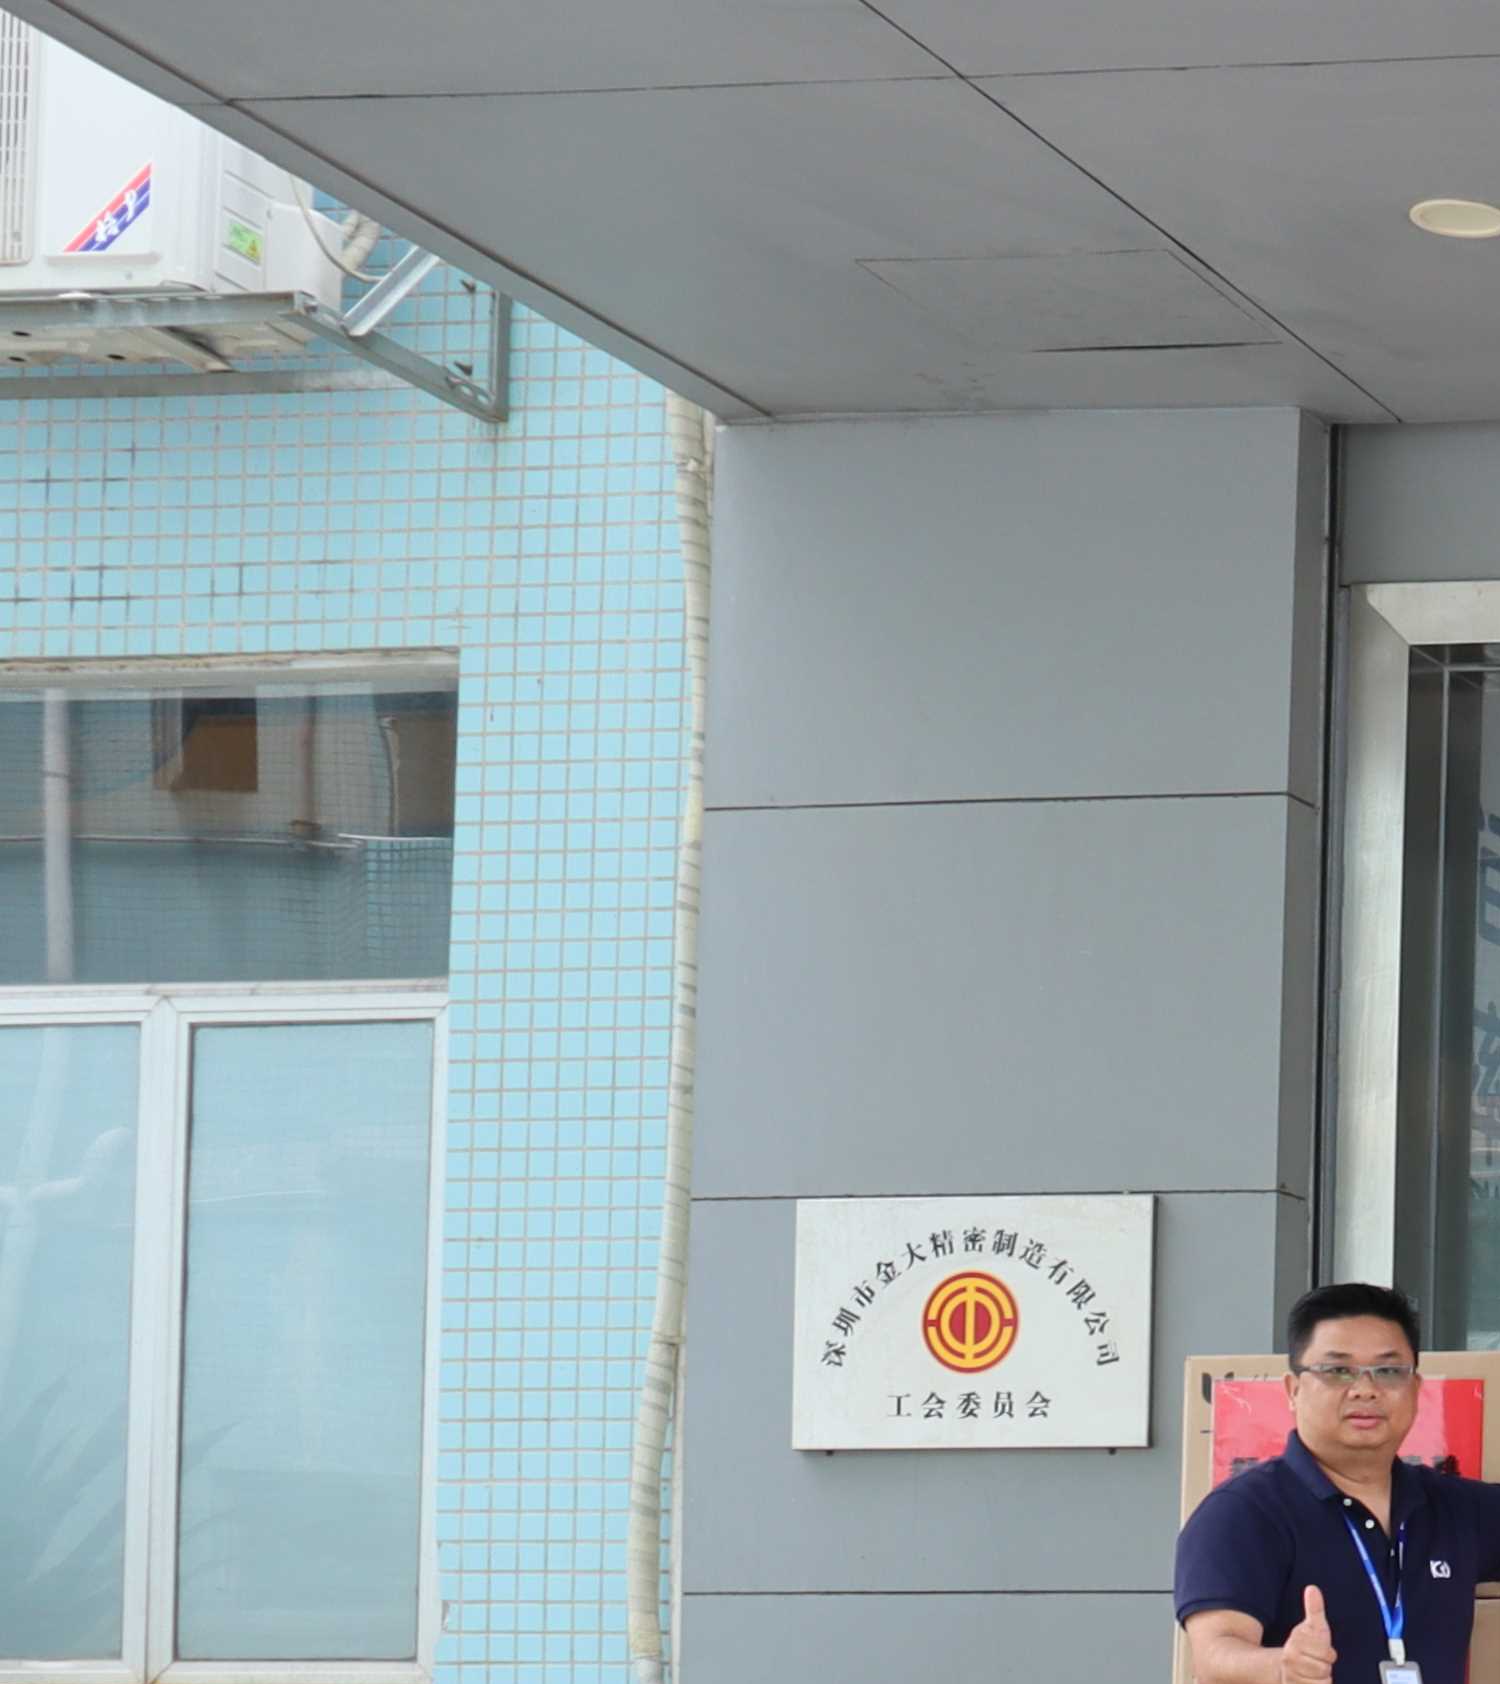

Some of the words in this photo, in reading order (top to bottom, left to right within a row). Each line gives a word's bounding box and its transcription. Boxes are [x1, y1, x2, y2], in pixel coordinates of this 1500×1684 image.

[821, 1226, 1120, 1368] 深圳市金大精密制造有限公司
[887, 1390, 1052, 1419] 工会委员会
